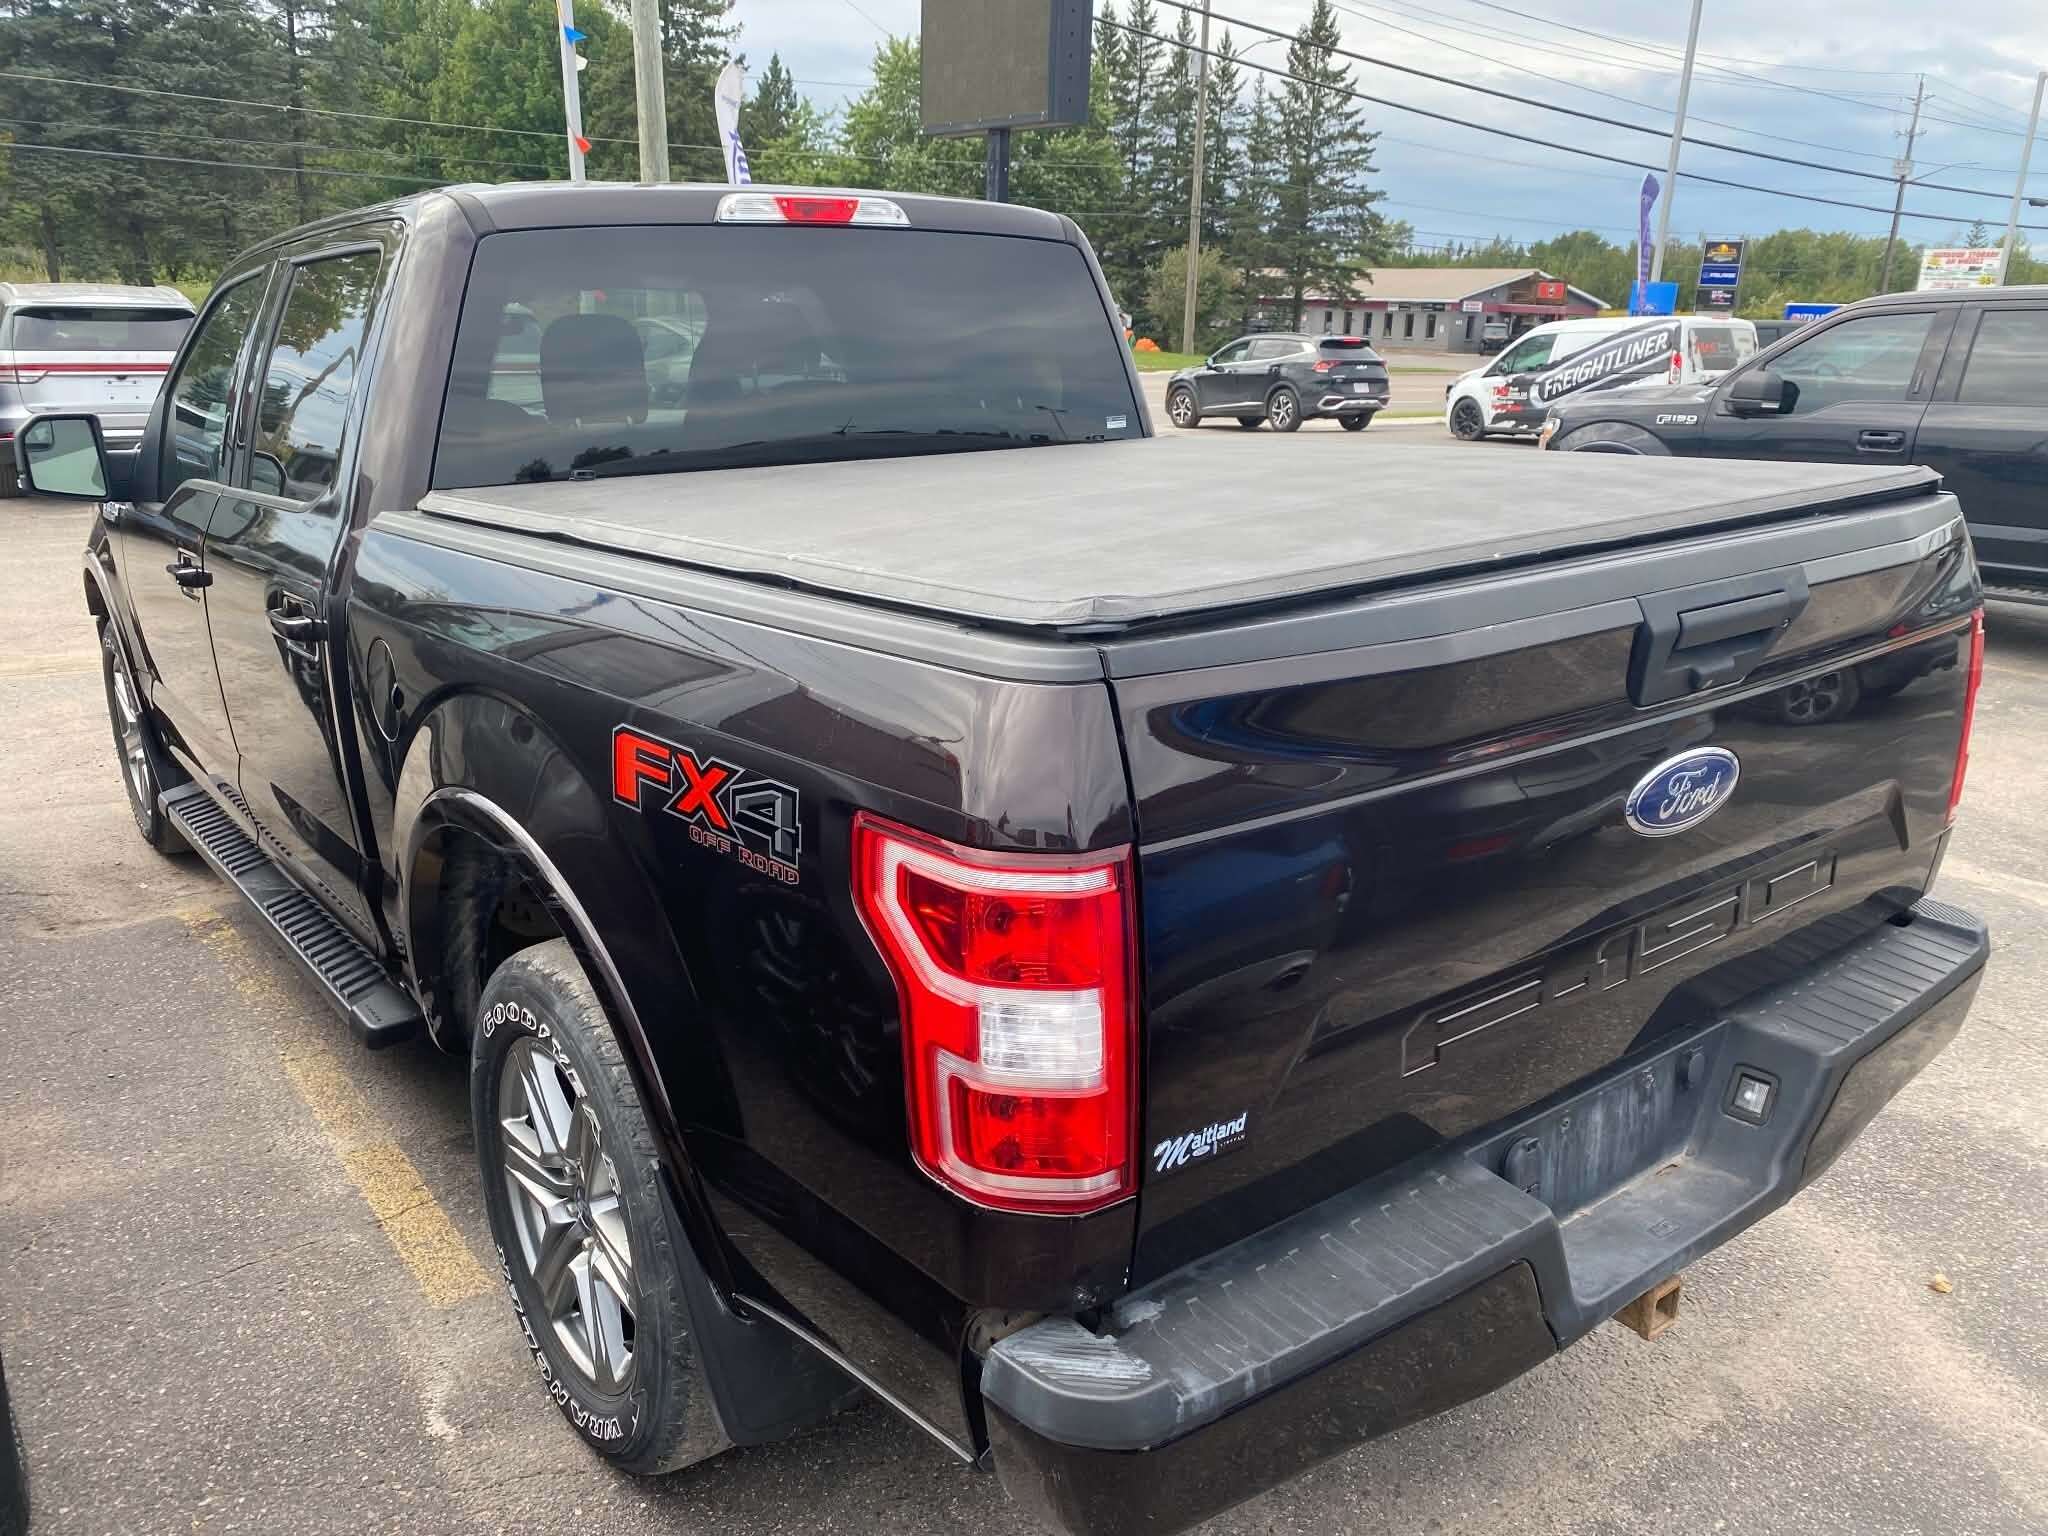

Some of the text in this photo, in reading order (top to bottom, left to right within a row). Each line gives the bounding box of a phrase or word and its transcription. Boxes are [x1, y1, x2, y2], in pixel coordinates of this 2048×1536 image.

[1543, 331, 1669, 400] FREIGHTLINER
[612, 723, 802, 869] FX4
[1659, 766, 1722, 820] Ford
[688, 824, 801, 885] OFF ROAD
[482, 1001, 622, 1197] GOODYEAR
[1153, 1110, 1248, 1173] Maitland
